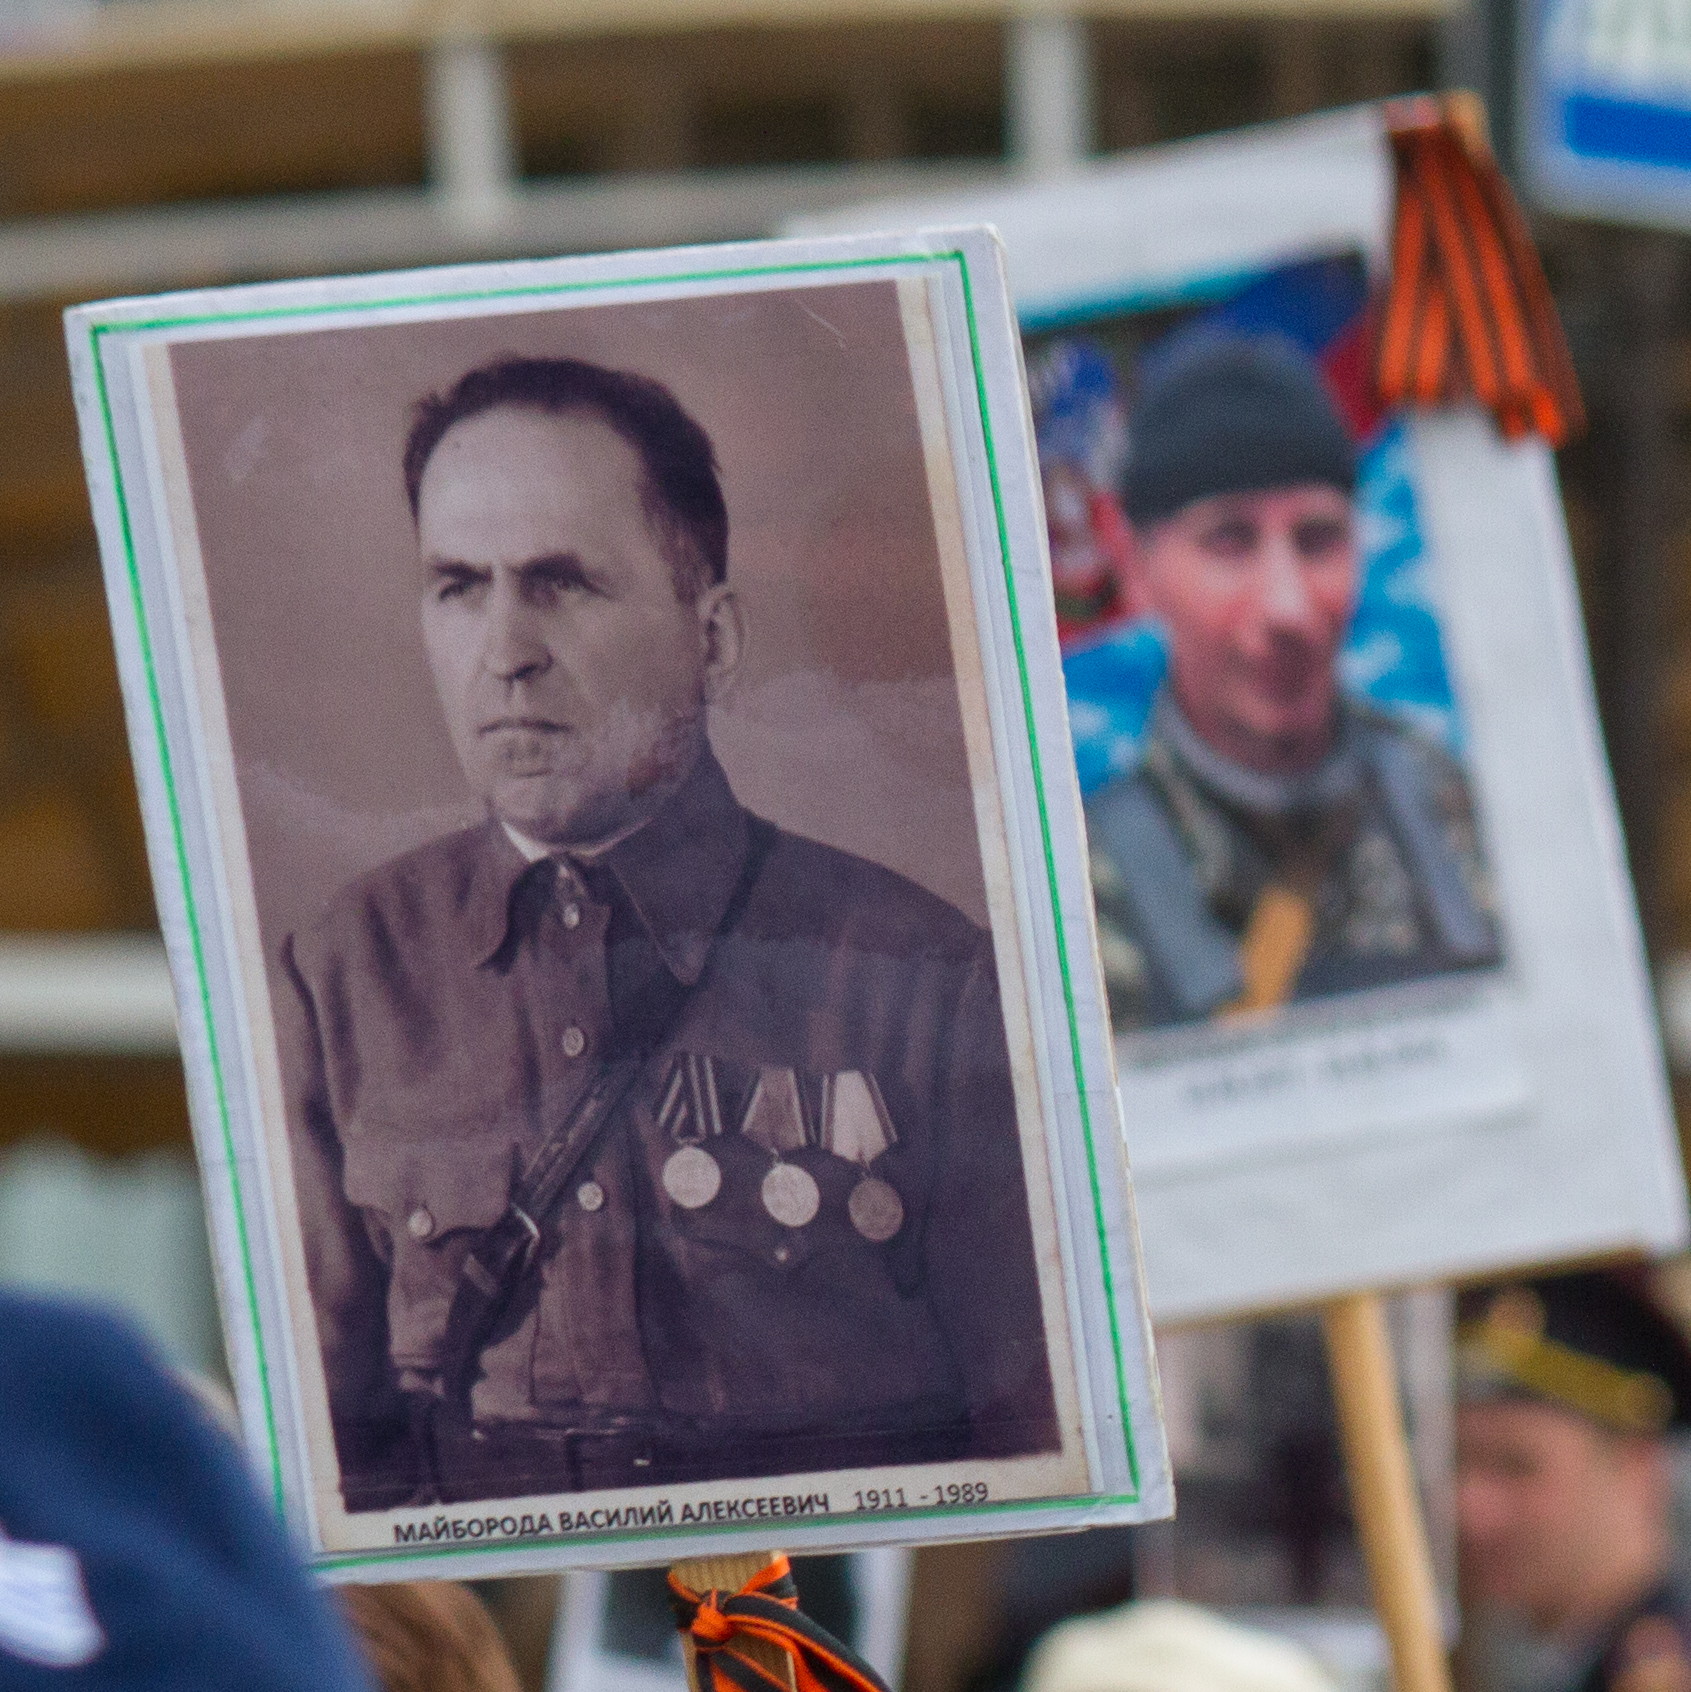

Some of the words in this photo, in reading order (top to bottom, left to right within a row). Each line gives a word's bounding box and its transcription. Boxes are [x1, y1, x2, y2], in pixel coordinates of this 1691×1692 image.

[394, 1516, 555, 1544] МАЙБОРОДА
[560, 1502, 674, 1533] ВАСИЛИЙ
[680, 1492, 831, 1523] АЛЕКСЕЕВИЧ
[854, 1487, 907, 1512] 1911
[934, 1481, 989, 1506] 1989
